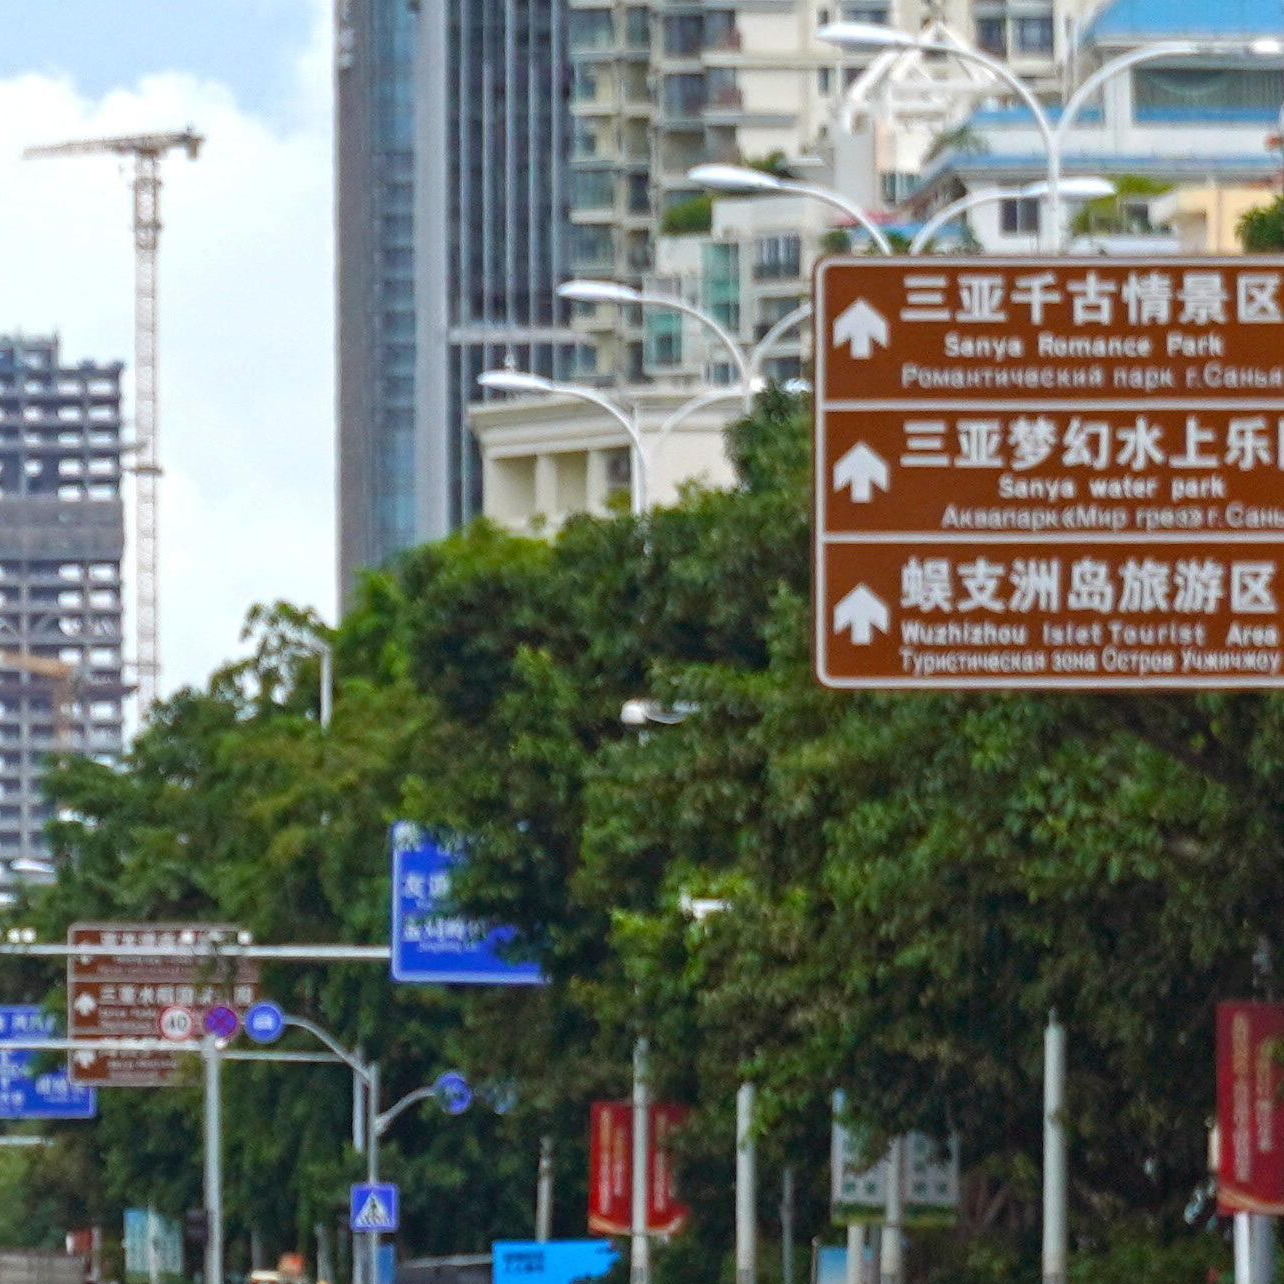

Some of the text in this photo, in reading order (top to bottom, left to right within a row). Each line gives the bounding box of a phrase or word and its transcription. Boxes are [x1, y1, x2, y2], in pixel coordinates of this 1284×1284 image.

[900, 271, 1284, 325] 三亚千古情景区
[944, 332, 1224, 361] Sanya Romance Park
[901, 363, 1105, 390] Романтический
[1113, 365, 1175, 393] парк
[900, 415, 1284, 471] 三亚梦幻水上乐
[998, 473, 1226, 503] Sanya water park
[900, 556, 1279, 614] 蜈支洲岛旅游区
[900, 619, 1280, 647] Wuzhizhou Islet Tourist Area
[1051, 650, 1099, 671] зона
[1100, 645, 1176, 674] Остров
